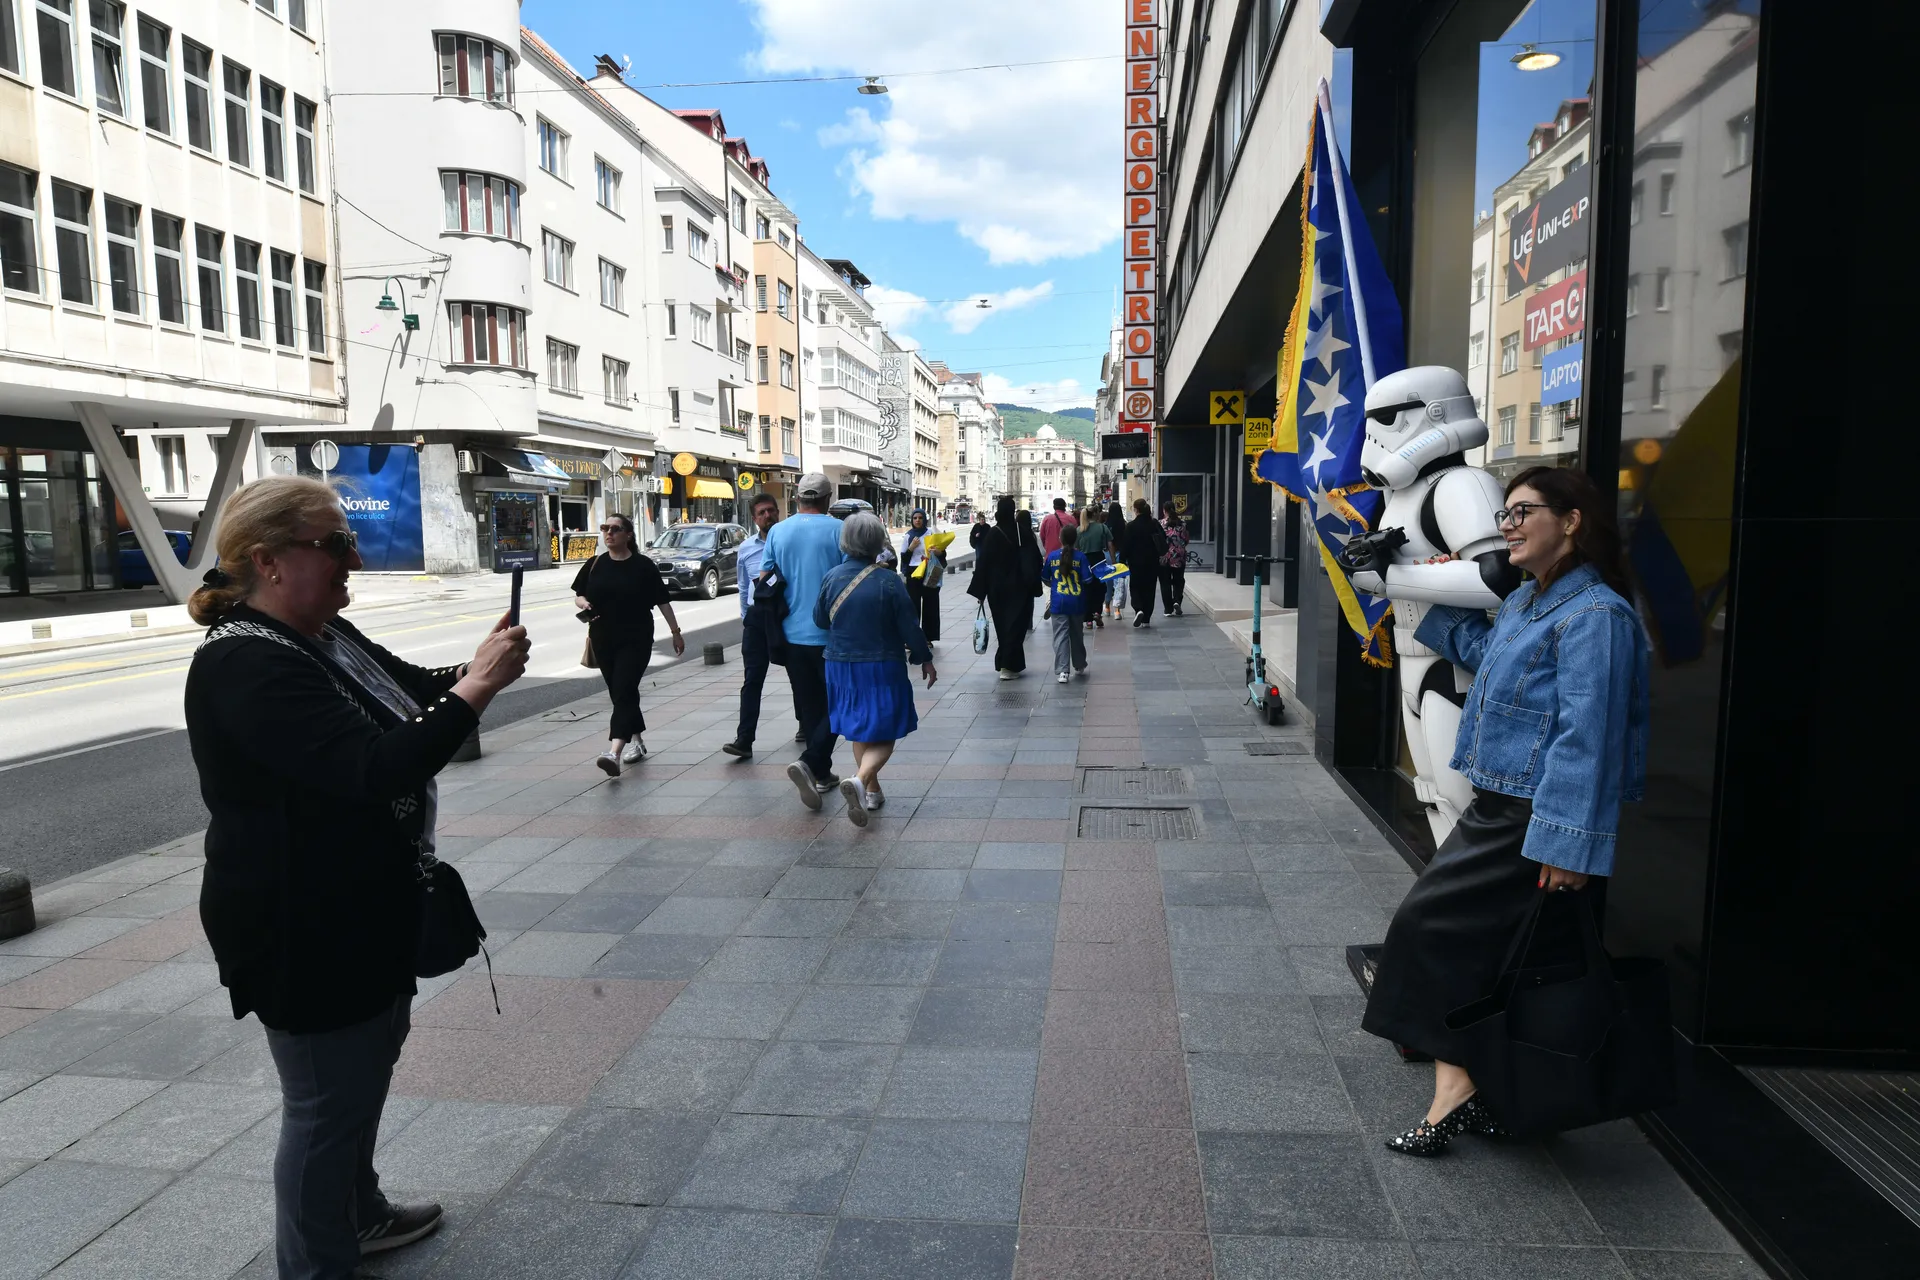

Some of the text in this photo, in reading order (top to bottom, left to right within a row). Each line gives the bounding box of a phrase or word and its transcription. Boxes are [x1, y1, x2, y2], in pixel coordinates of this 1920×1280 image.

[1129, 0, 1154, 386] ENERGOPETROL
[1537, 196, 1589, 244] UNI-EXP
[1248, 421, 1269, 432] 24h
[700, 465, 721, 477] PEKARA
[338, 496, 390, 511] Novine
[356, 512, 367, 520] lice
[368, 512, 385, 520] ulice
[1054, 569, 1081, 596] 20
